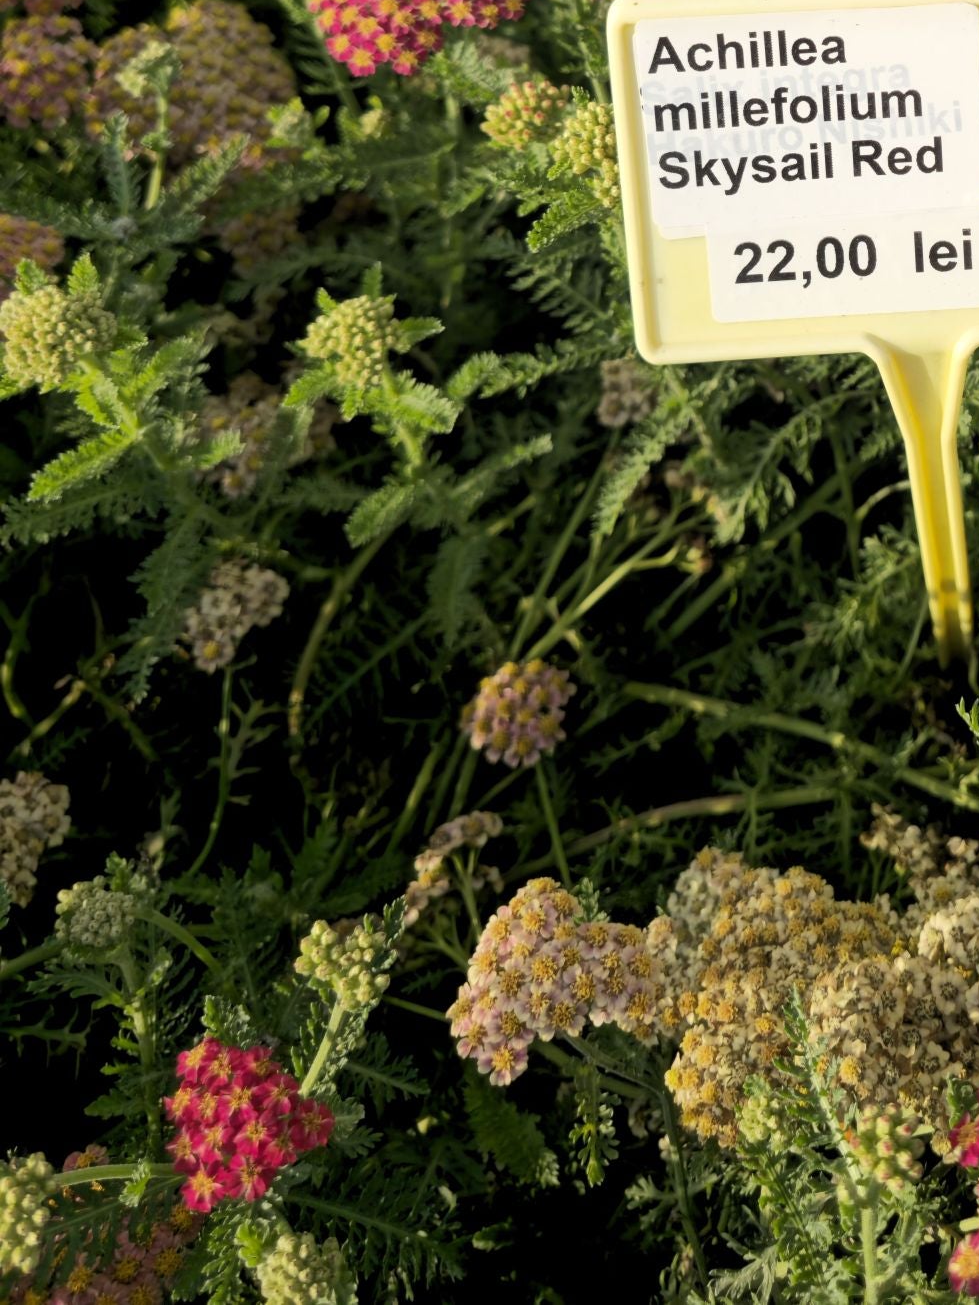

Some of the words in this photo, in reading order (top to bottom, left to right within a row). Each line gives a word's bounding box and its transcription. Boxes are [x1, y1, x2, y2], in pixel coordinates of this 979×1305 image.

[648, 30, 846, 74] Achillea
[654, 85, 923, 132] millefolium
[658, 142, 834, 196] Skysail
[851, 136, 943, 177] Red
[734, 234, 877, 289] 22,00
[913, 229, 973, 273] lei
